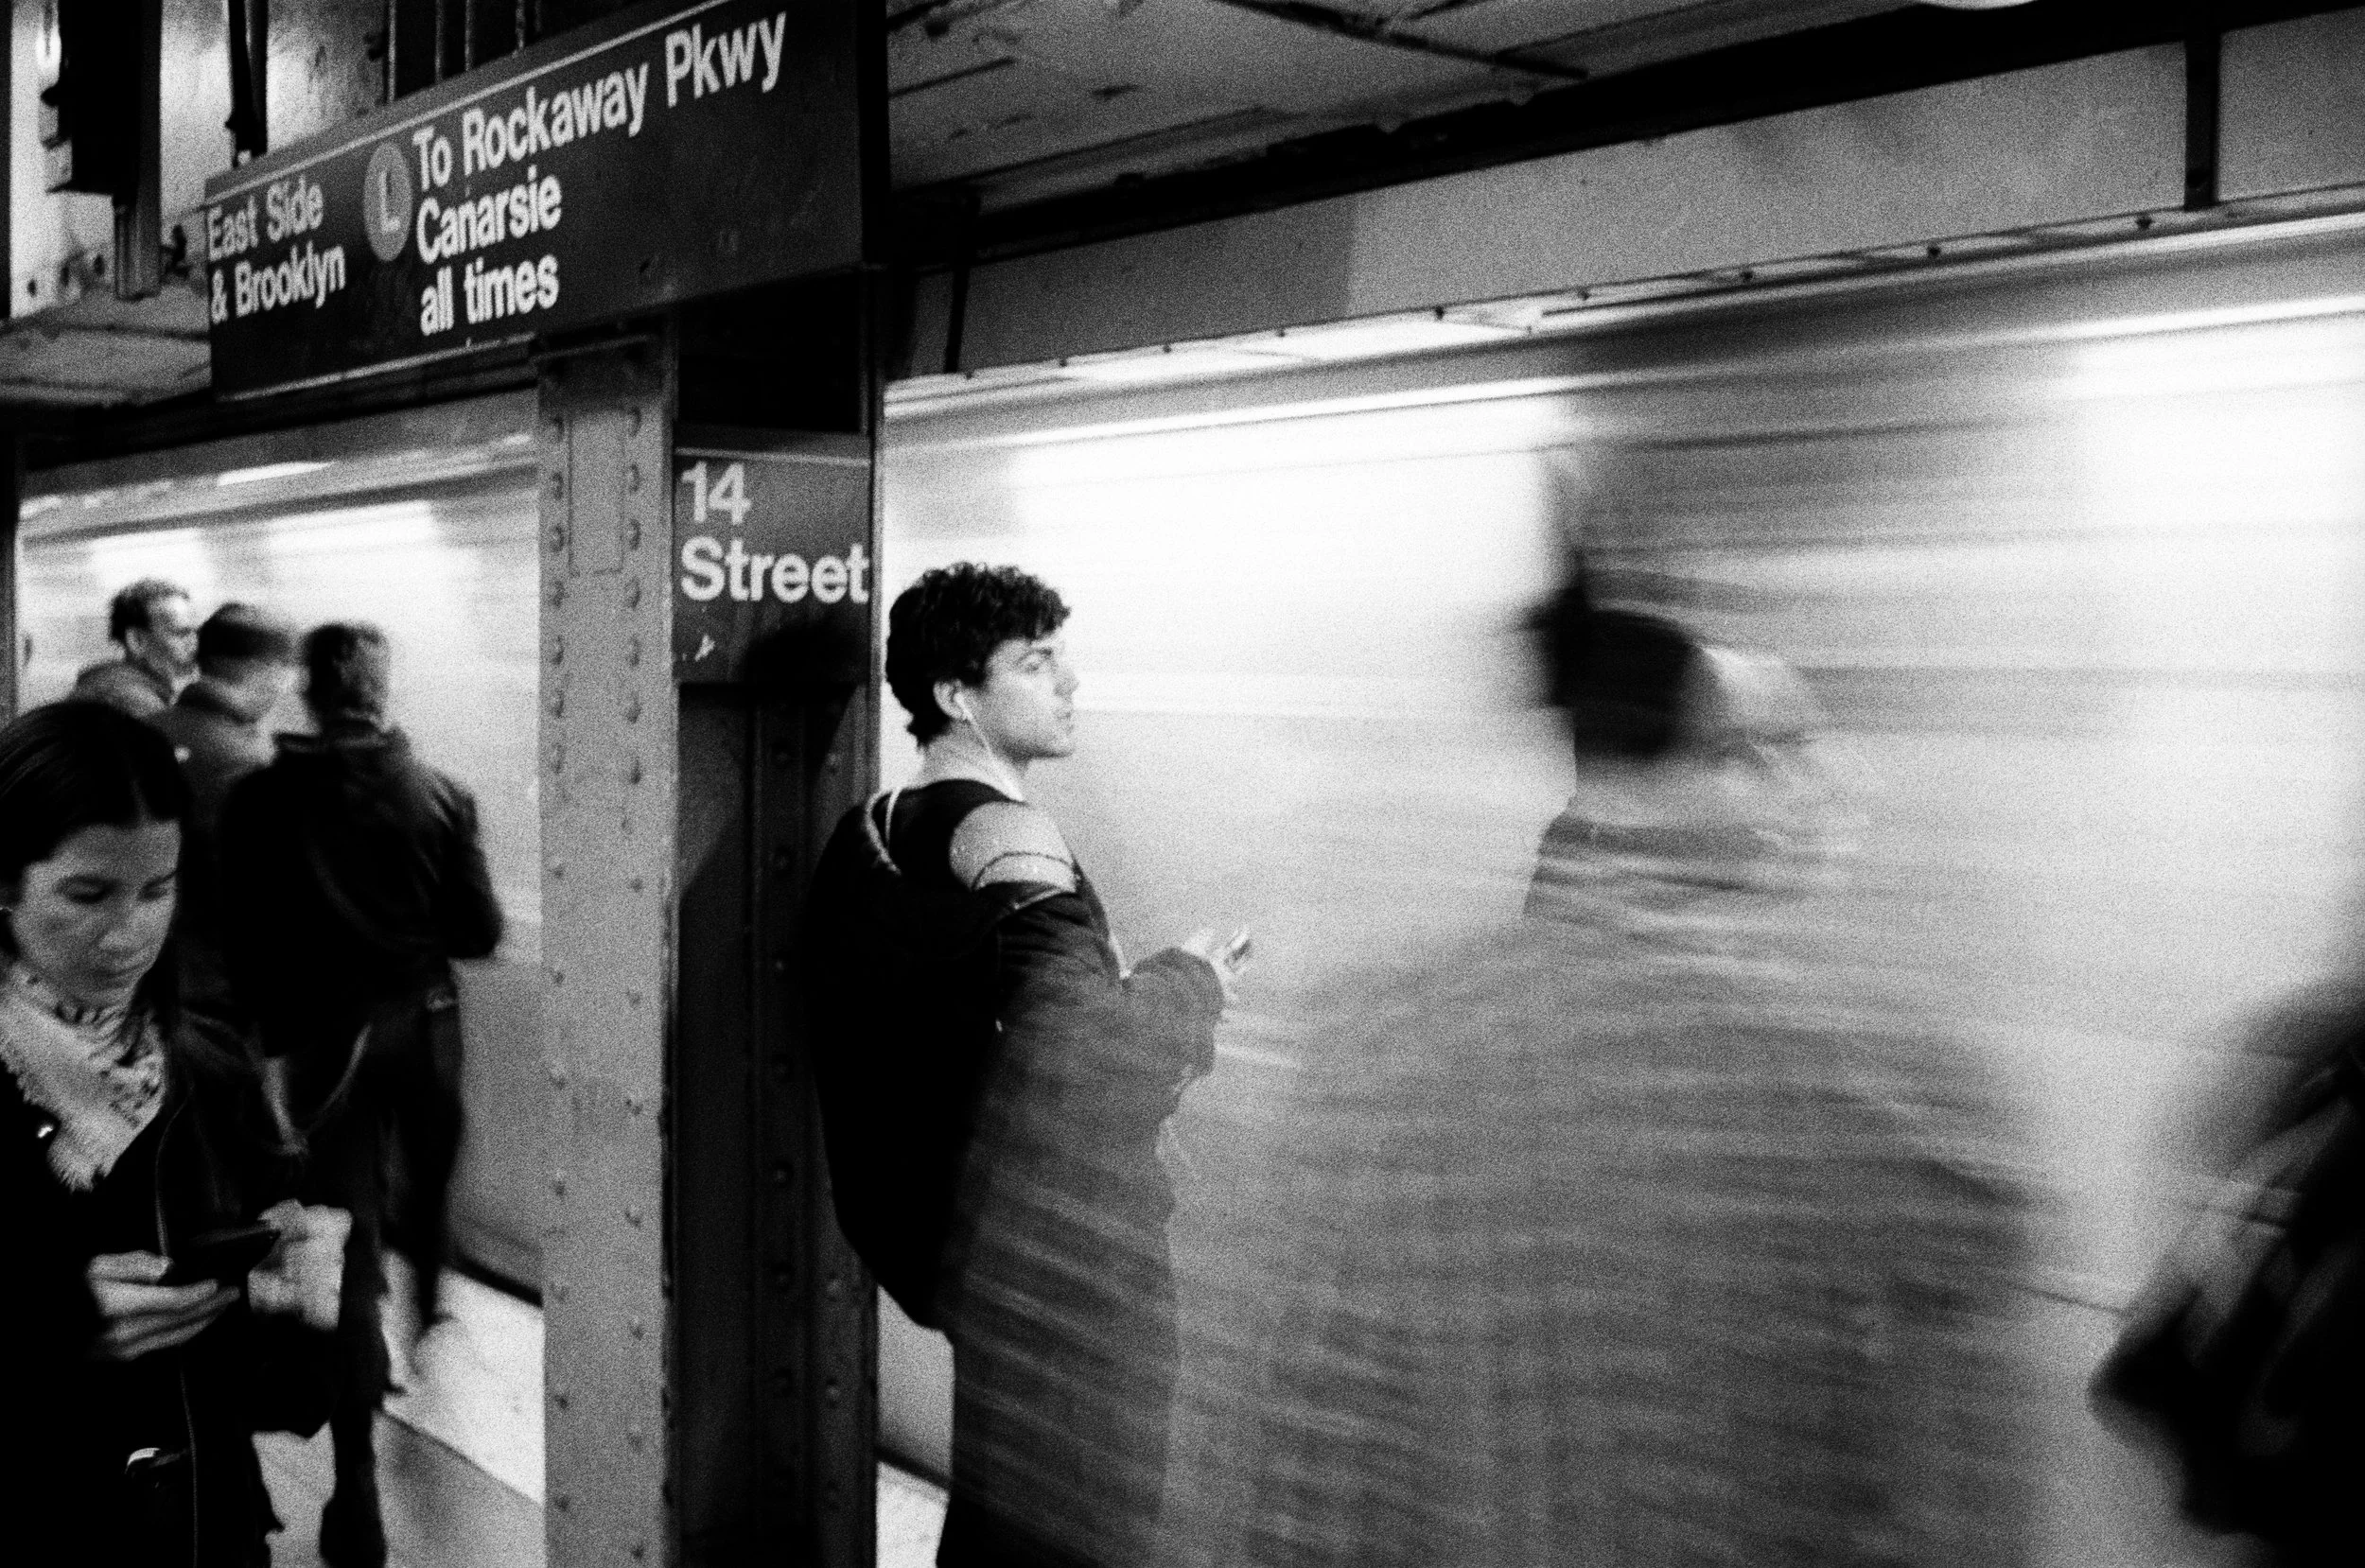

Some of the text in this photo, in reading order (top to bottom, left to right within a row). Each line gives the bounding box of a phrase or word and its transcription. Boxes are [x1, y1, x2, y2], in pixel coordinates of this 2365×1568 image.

[412, 11, 787, 190] To Rockaway Pkwy
[207, 175, 324, 262] East Side
[377, 169, 401, 233] L
[416, 164, 562, 265] Canarsie
[211, 239, 346, 325] & Brooklyn
[420, 254, 559, 336] all times
[681, 460, 752, 525] 14
[680, 536, 869, 604] Street
